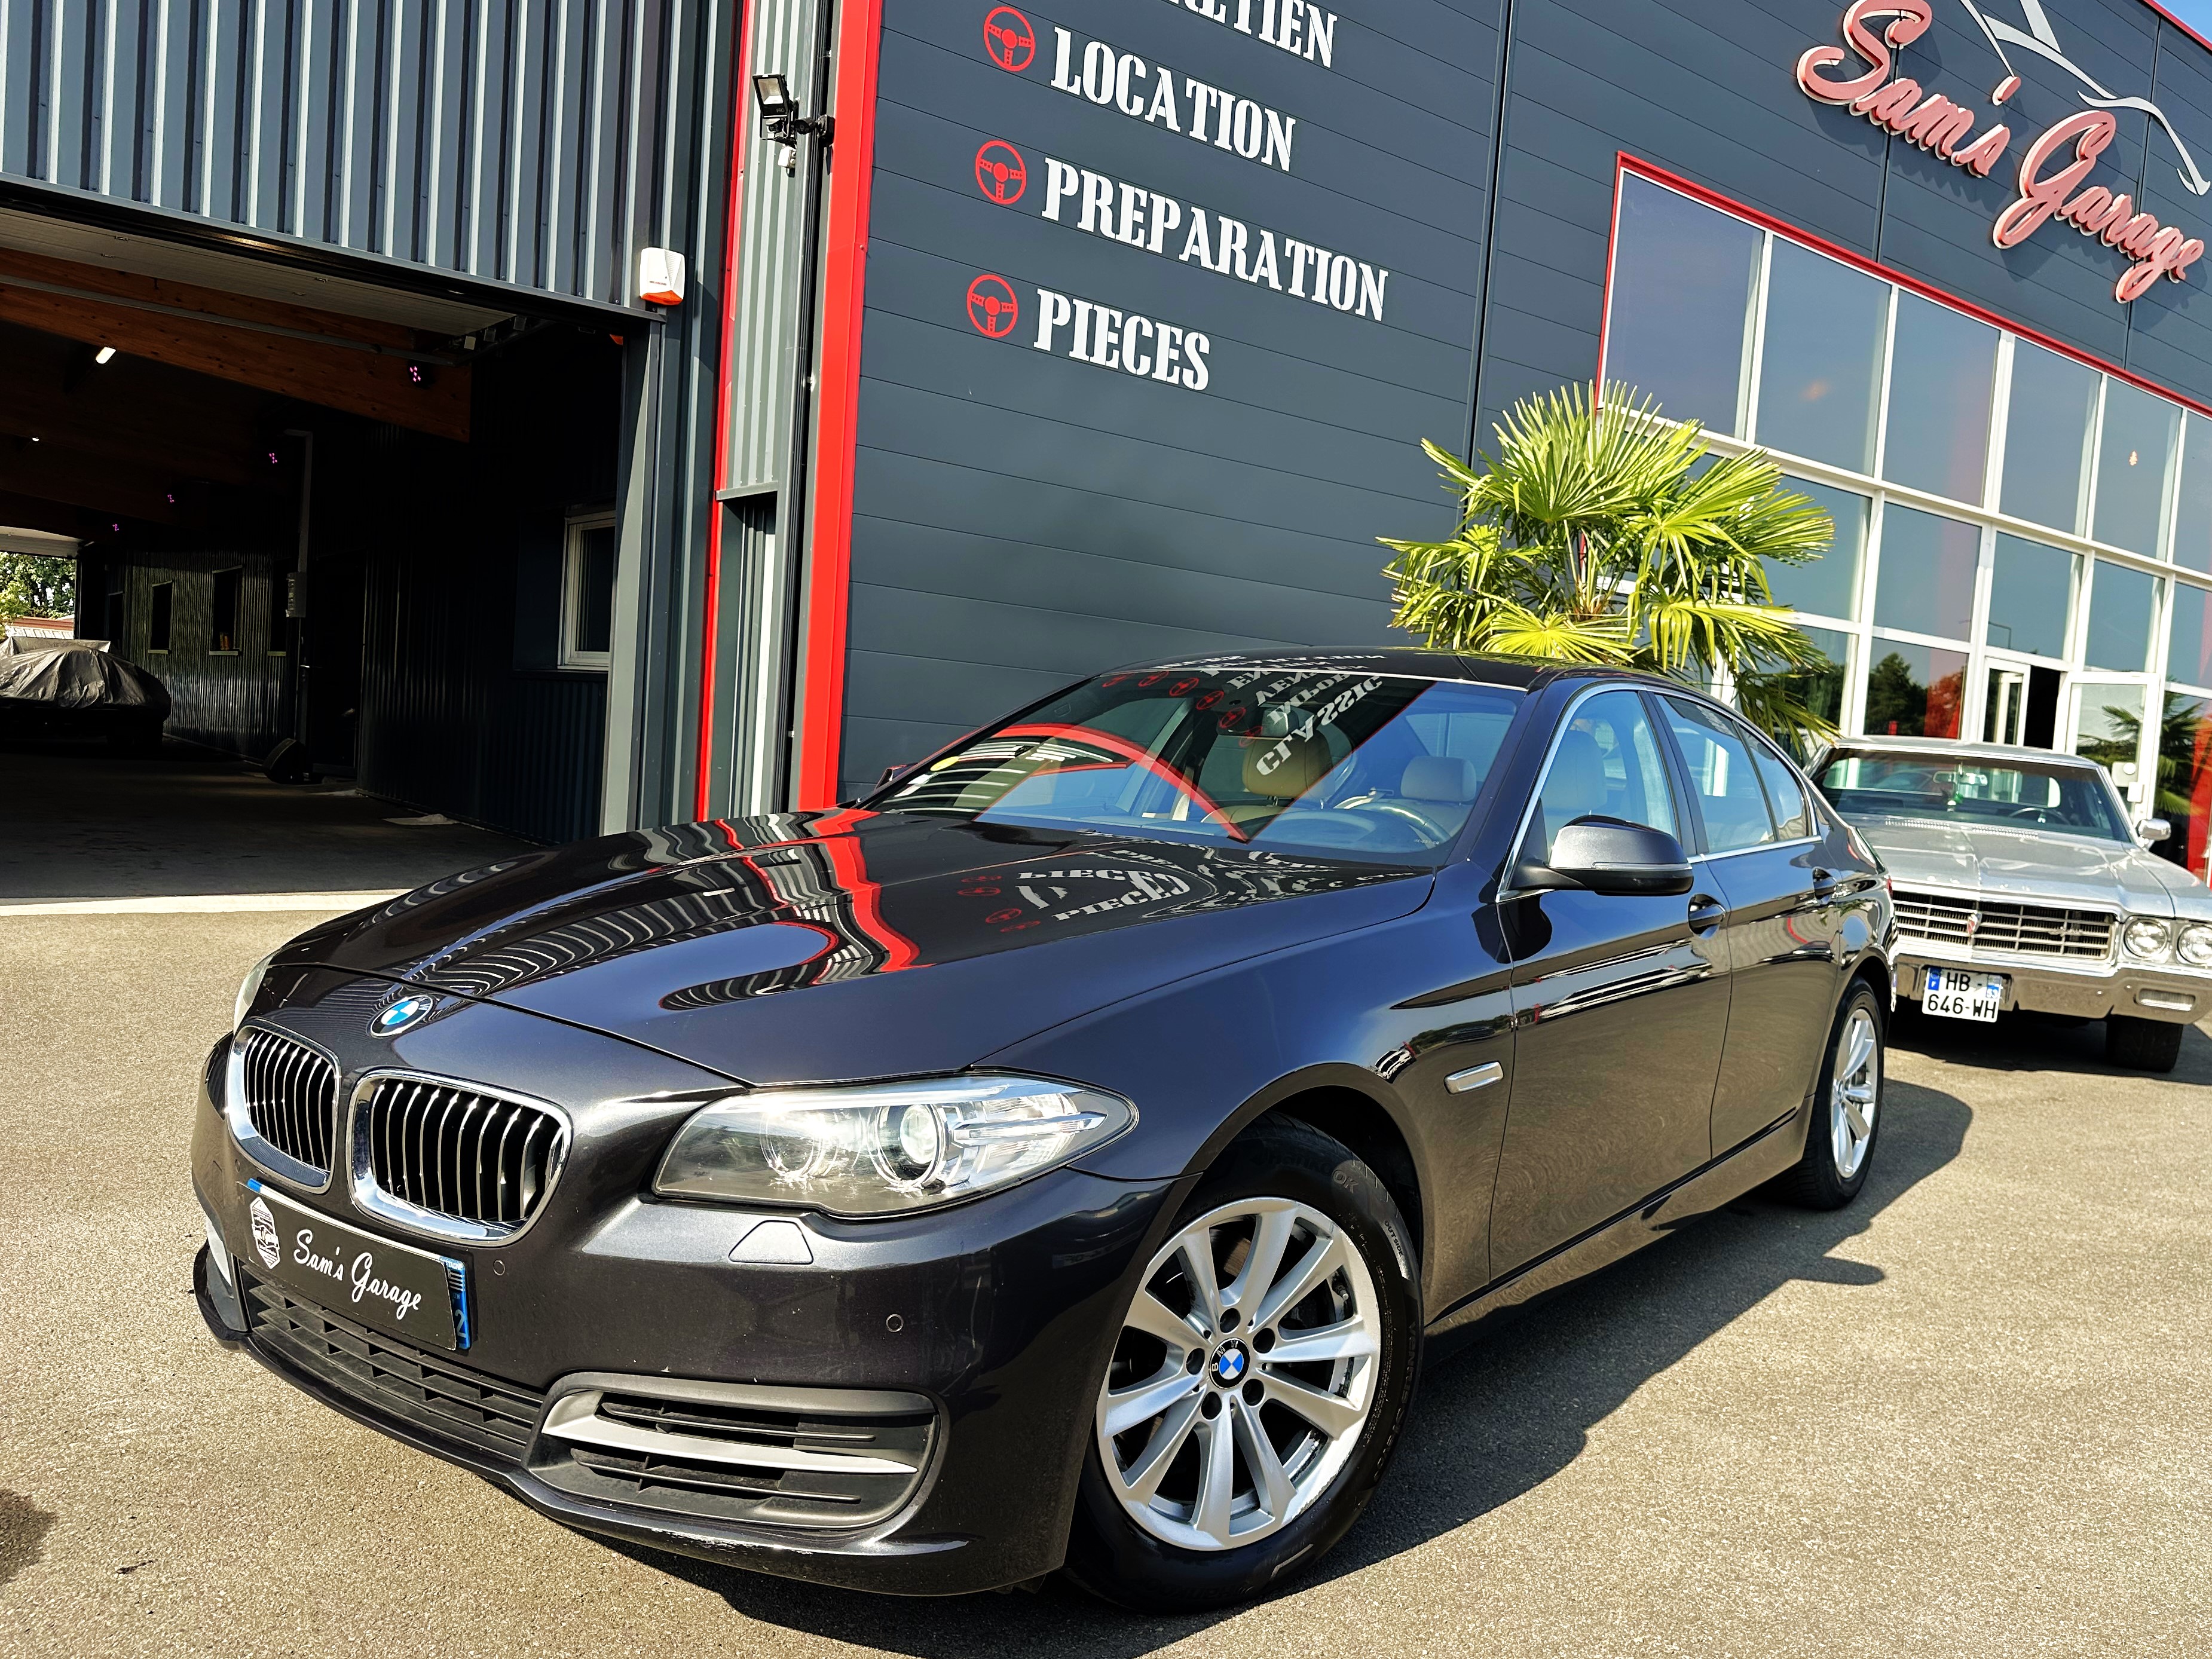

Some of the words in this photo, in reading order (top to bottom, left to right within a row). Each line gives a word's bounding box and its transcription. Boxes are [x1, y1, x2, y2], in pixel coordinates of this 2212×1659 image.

[1050, 26, 1296, 173] LOCATION
[1797, 0, 2021, 178] Sam's
[1993, 110, 2204, 304] Garage
[1041, 157, 1389, 322] PREPARATION
[1033, 288, 1210, 391] PIECES
[1928, 994, 1997, 1019] 646-WH
[1945, 972, 1971, 991] HB
[293, 1229, 344, 1281] Sam's
[351, 1252, 421, 1320] Garage
[1384, 1220, 1404, 1257] OUTSIDE
[1210, 1339, 1239, 1372] BMW
